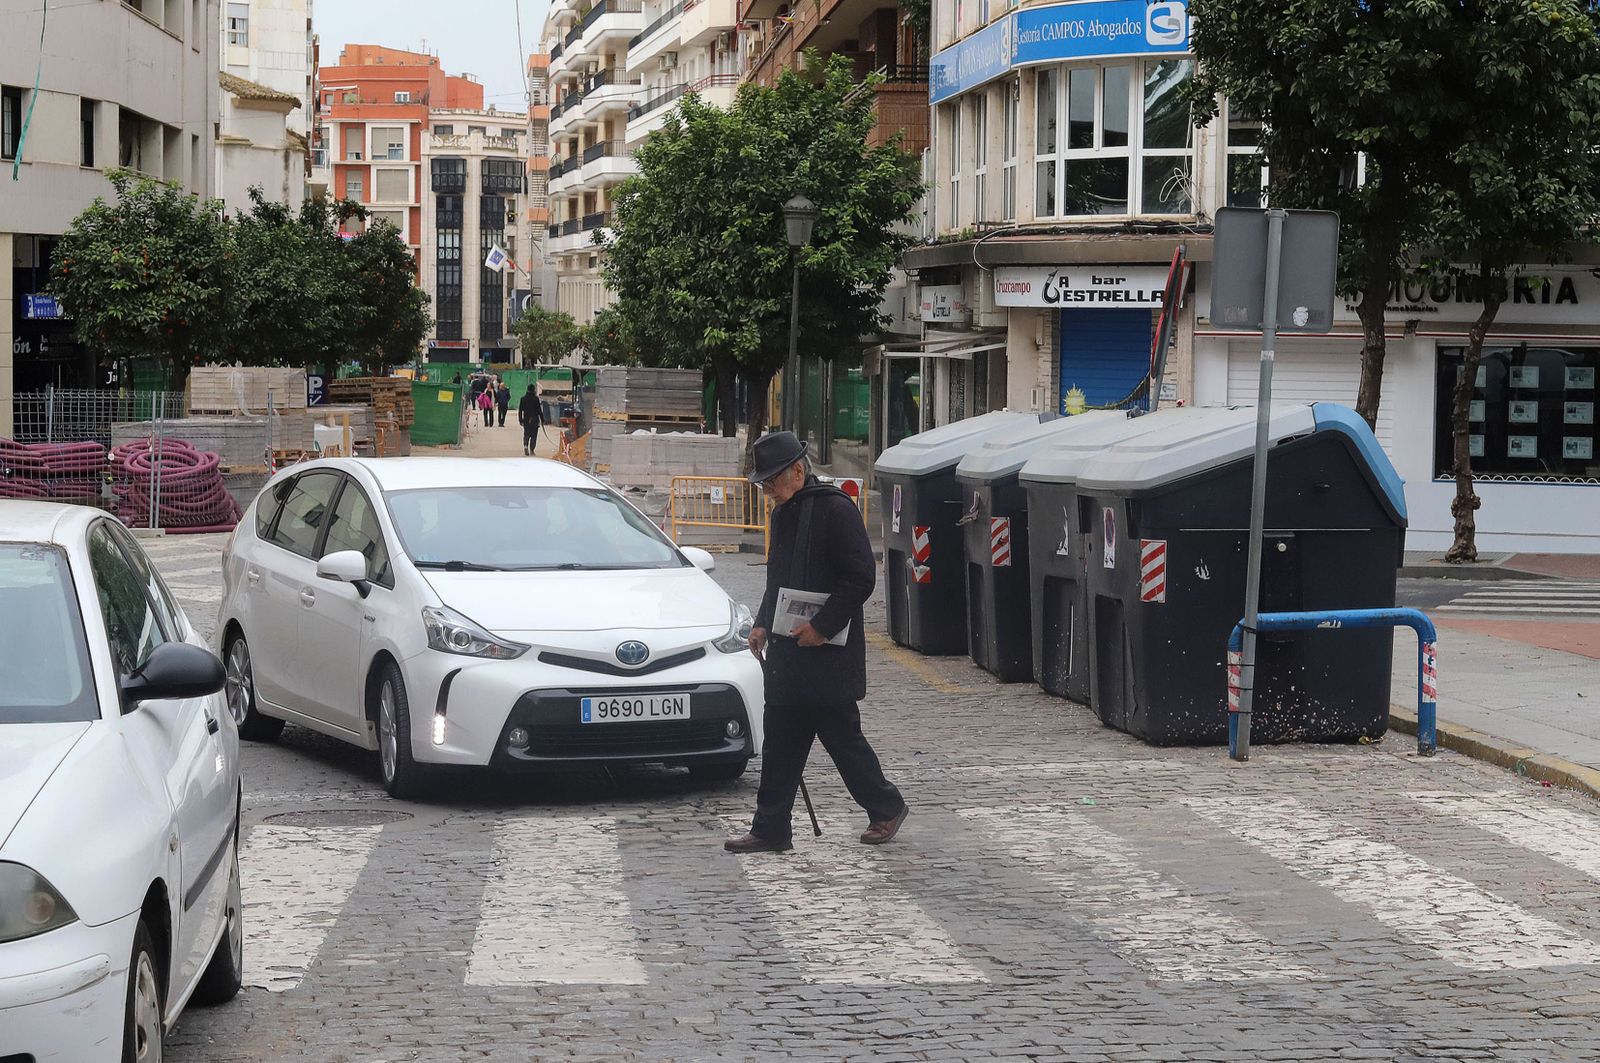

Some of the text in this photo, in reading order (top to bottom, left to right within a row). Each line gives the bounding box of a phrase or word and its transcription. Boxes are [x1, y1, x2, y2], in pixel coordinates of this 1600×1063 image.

[1041, 20, 1084, 41] CAMPOS
[1087, 17, 1142, 41] Abogados
[995, 279, 1031, 296] Cruzcampo
[1091, 275, 1126, 286] bar
[1062, 290, 1165, 303] ESTRELLA
[598, 697, 684, 719] 9690 LGN
